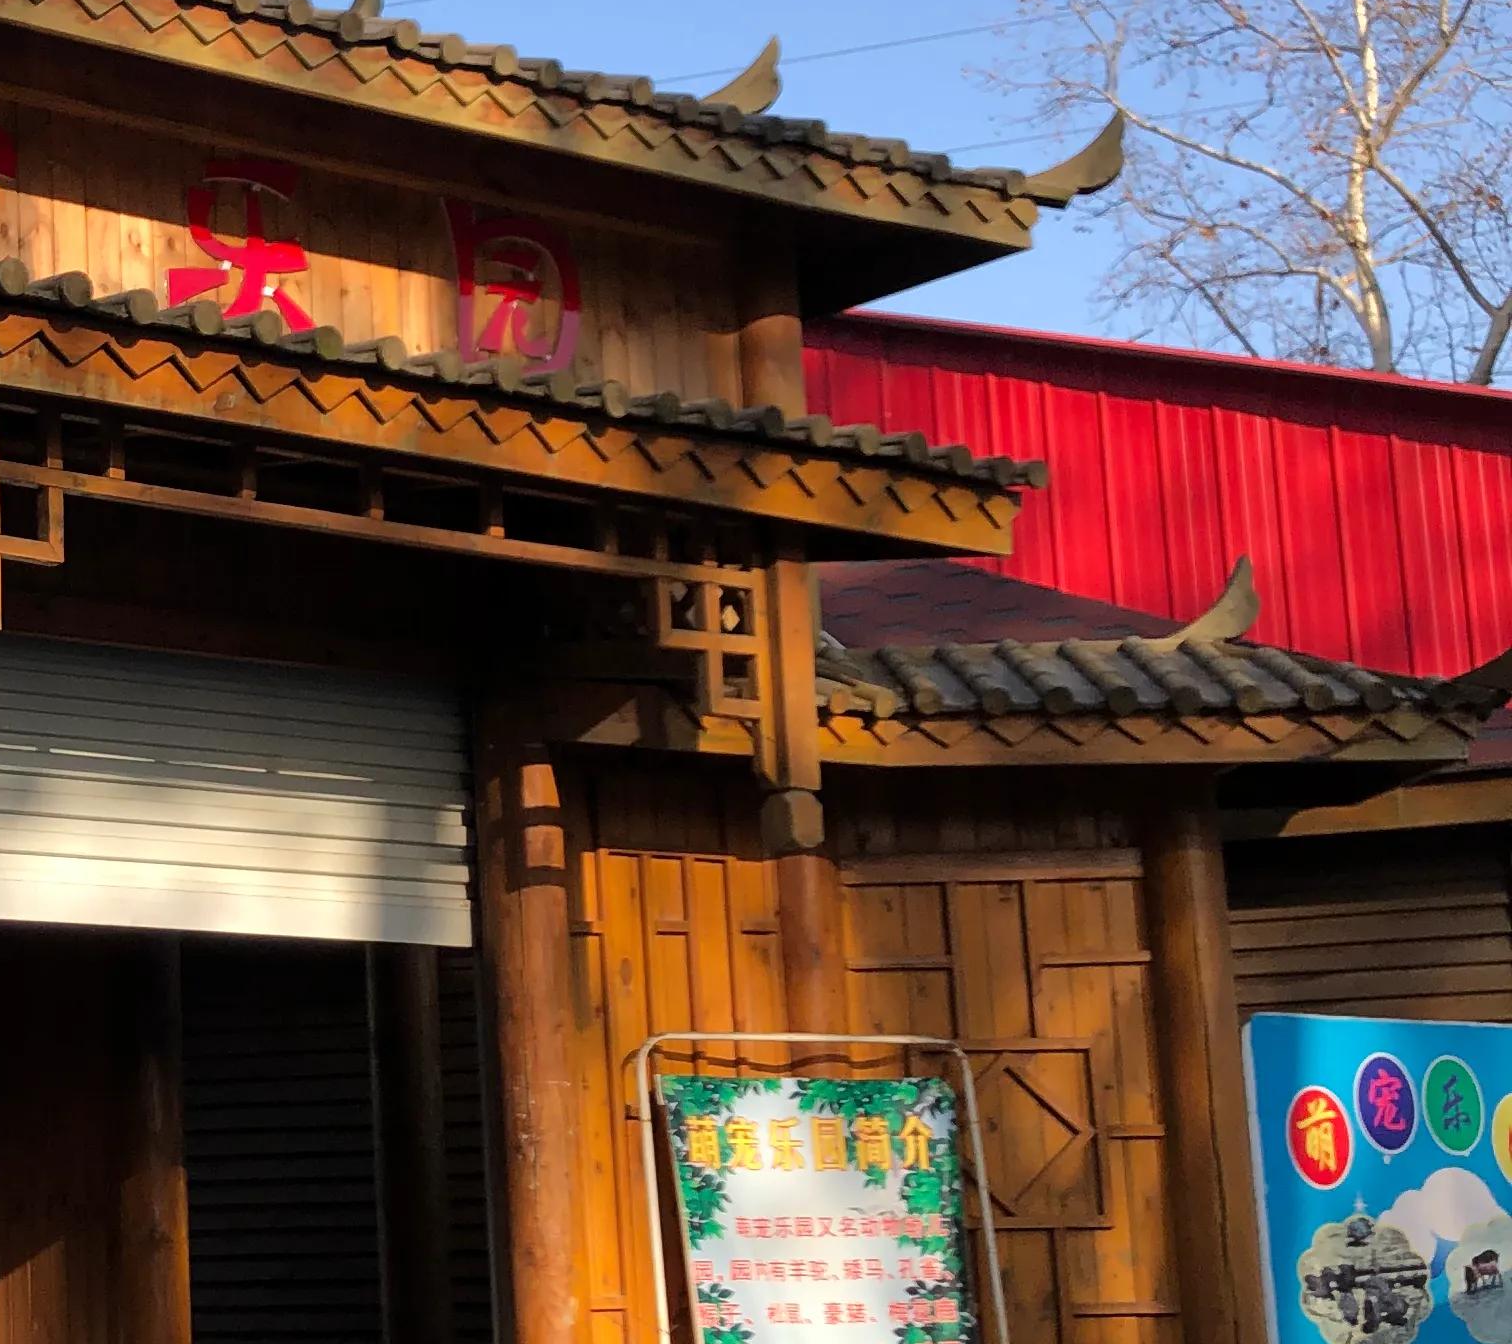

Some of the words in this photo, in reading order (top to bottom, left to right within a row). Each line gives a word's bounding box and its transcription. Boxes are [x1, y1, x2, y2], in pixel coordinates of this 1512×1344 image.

[685, 1115, 934, 1172] 萌宠乐园简介
[1296, 1067, 1512, 1173] 萌宠乐
